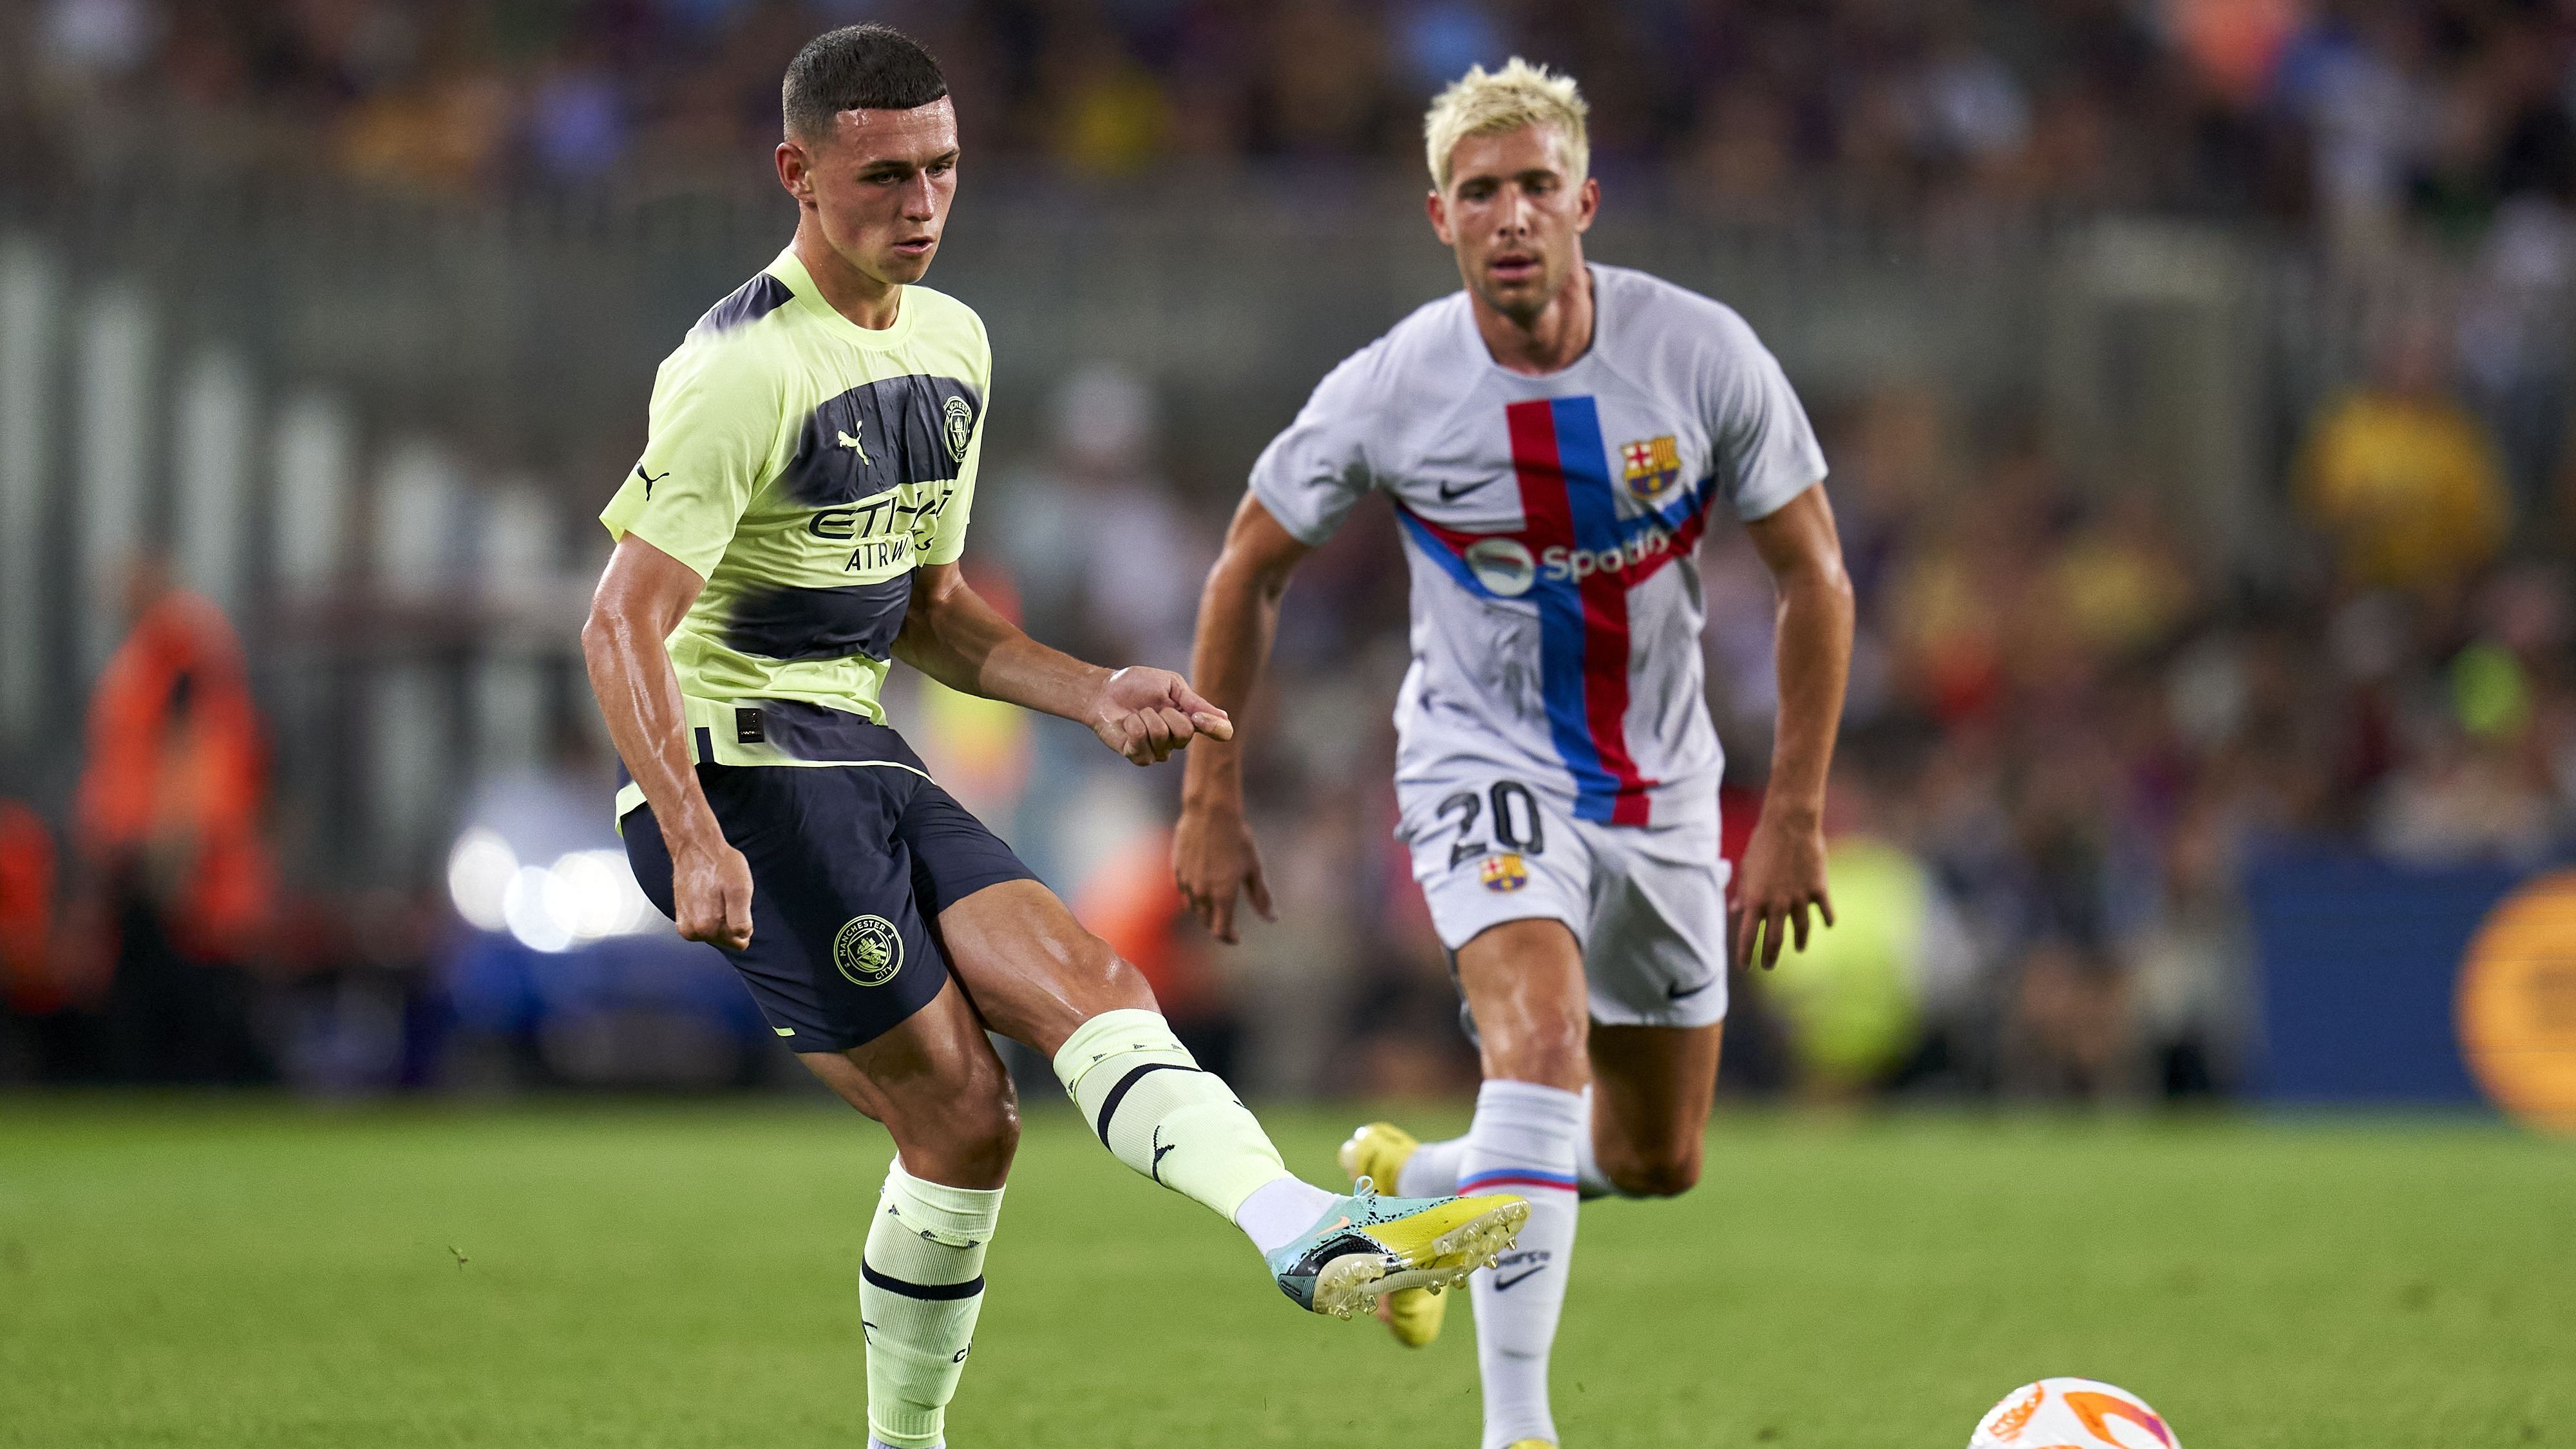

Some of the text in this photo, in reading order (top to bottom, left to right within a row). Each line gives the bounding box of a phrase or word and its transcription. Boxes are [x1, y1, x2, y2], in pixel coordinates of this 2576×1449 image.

[1437, 780, 1544, 872] 20
[839, 920, 886, 957] MANCHESTER
[875, 964, 893, 980] CITY
